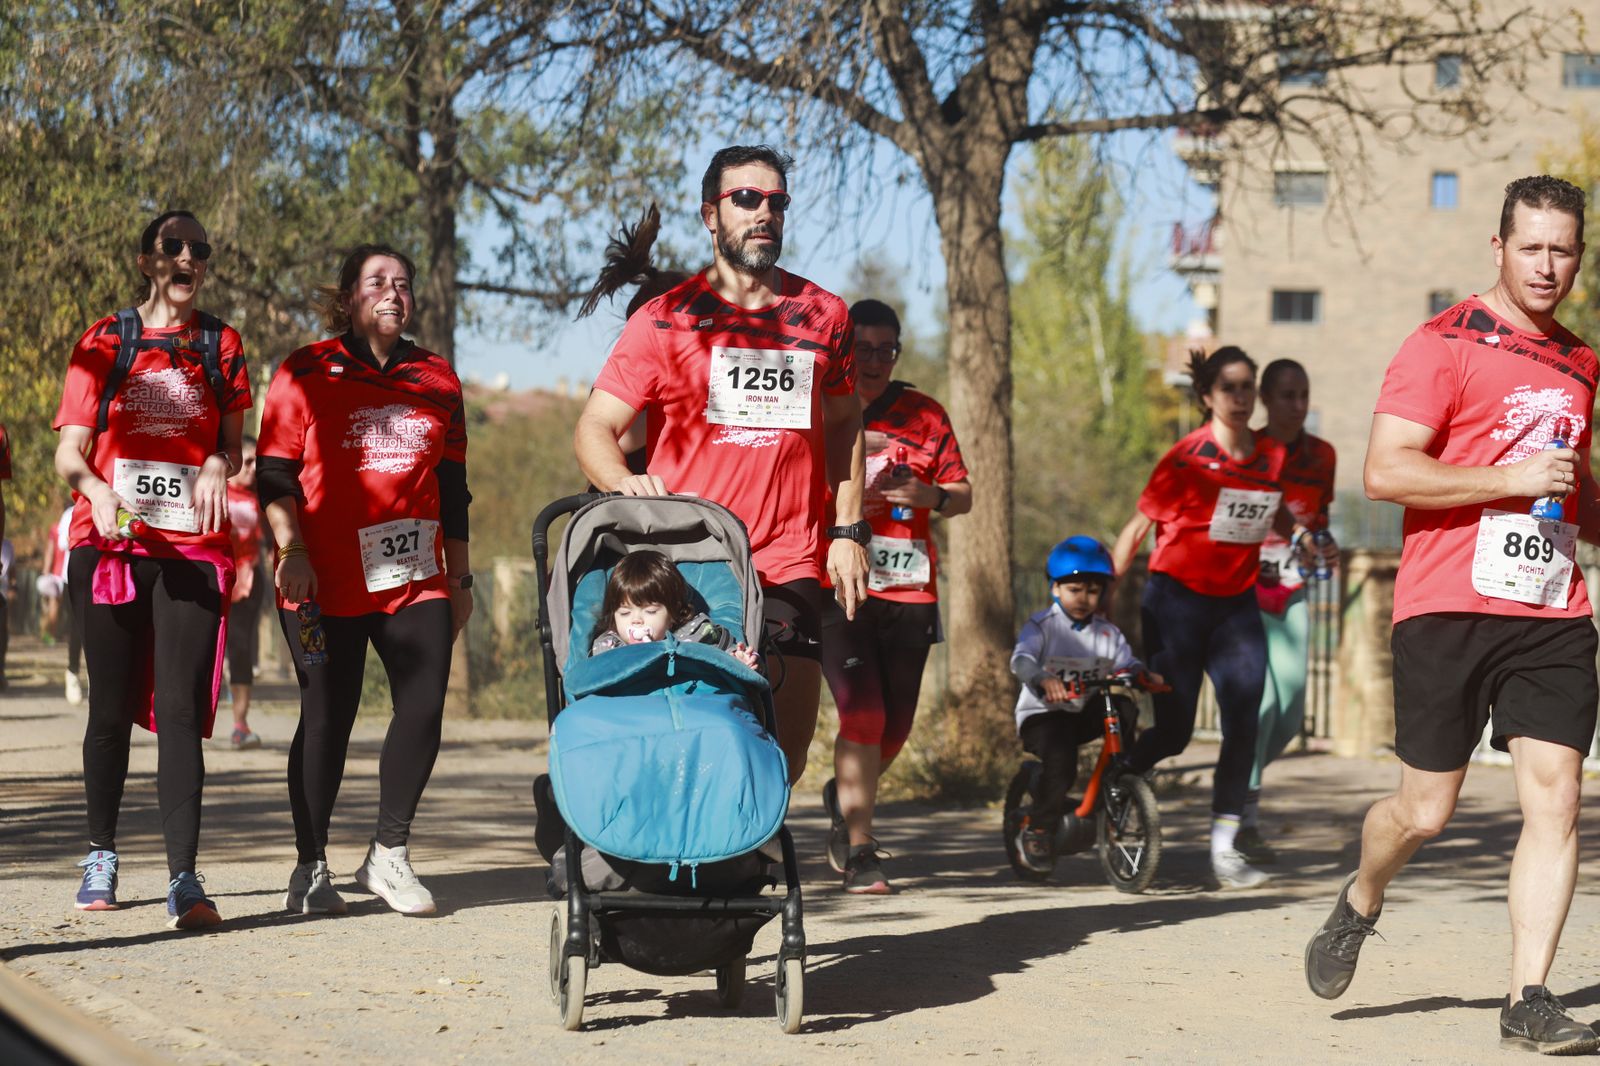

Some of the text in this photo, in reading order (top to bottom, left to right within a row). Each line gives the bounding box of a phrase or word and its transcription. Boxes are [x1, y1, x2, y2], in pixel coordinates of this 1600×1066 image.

[727, 366, 795, 392] 1256
[127, 384, 200, 401] carrera
[745, 395, 779, 404] IRON MAN
[352, 420, 425, 436] carrera
[353, 436, 426, 450] cruzroja.es
[136, 475, 182, 498] 565
[157, 500, 185, 509] VICTORIA
[1227, 502, 1269, 520] 1257
[380, 530, 420, 558] 327
[1503, 531, 1555, 563] 869
[396, 554, 420, 565] BEATRIZ
[875, 550, 914, 569] 317
[1517, 564, 1546, 577] PICHITA
